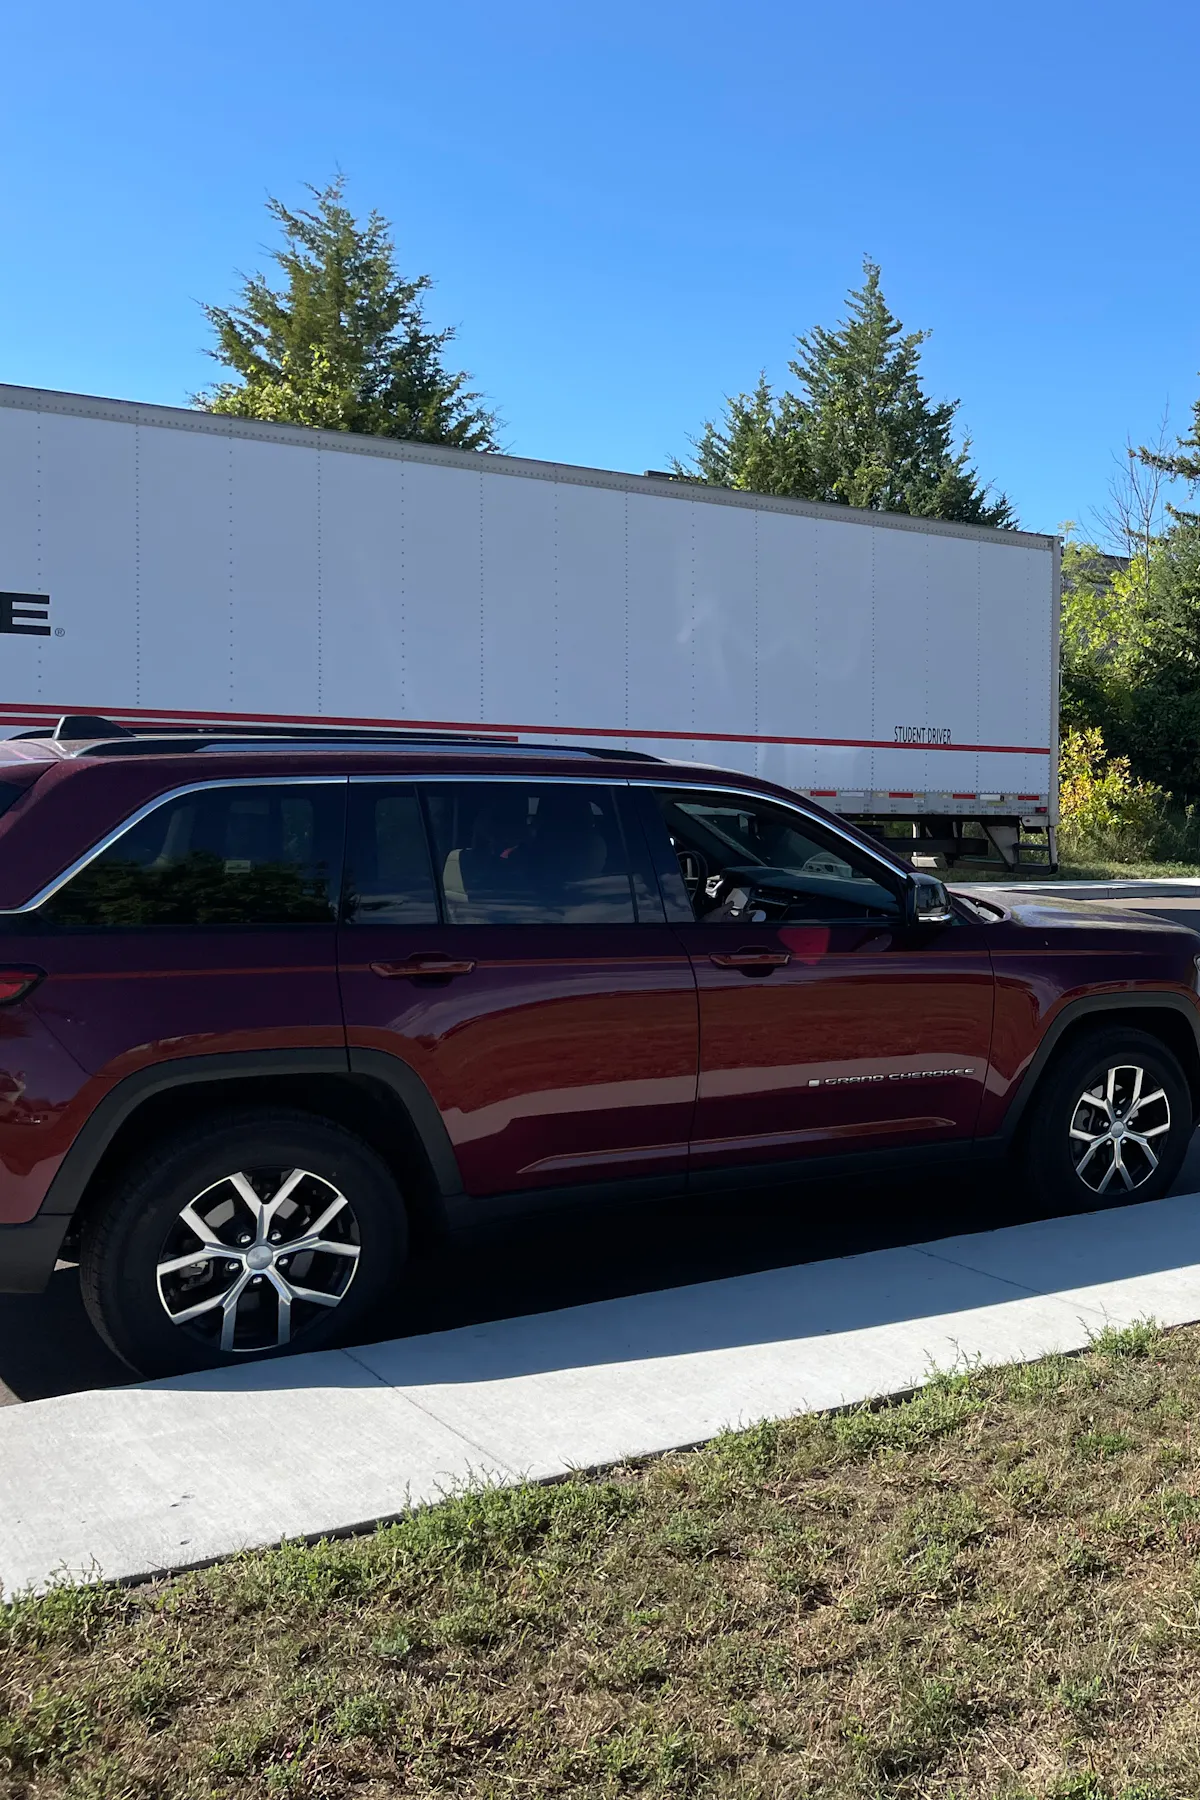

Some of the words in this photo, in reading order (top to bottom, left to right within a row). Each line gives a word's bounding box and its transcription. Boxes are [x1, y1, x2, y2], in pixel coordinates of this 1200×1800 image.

[894, 725, 926, 743] STUDENT
[927, 727, 952, 745] DRIVER
[825, 1074, 884, 1085] GRAND
[888, 1068, 975, 1080] CHEROKEE
